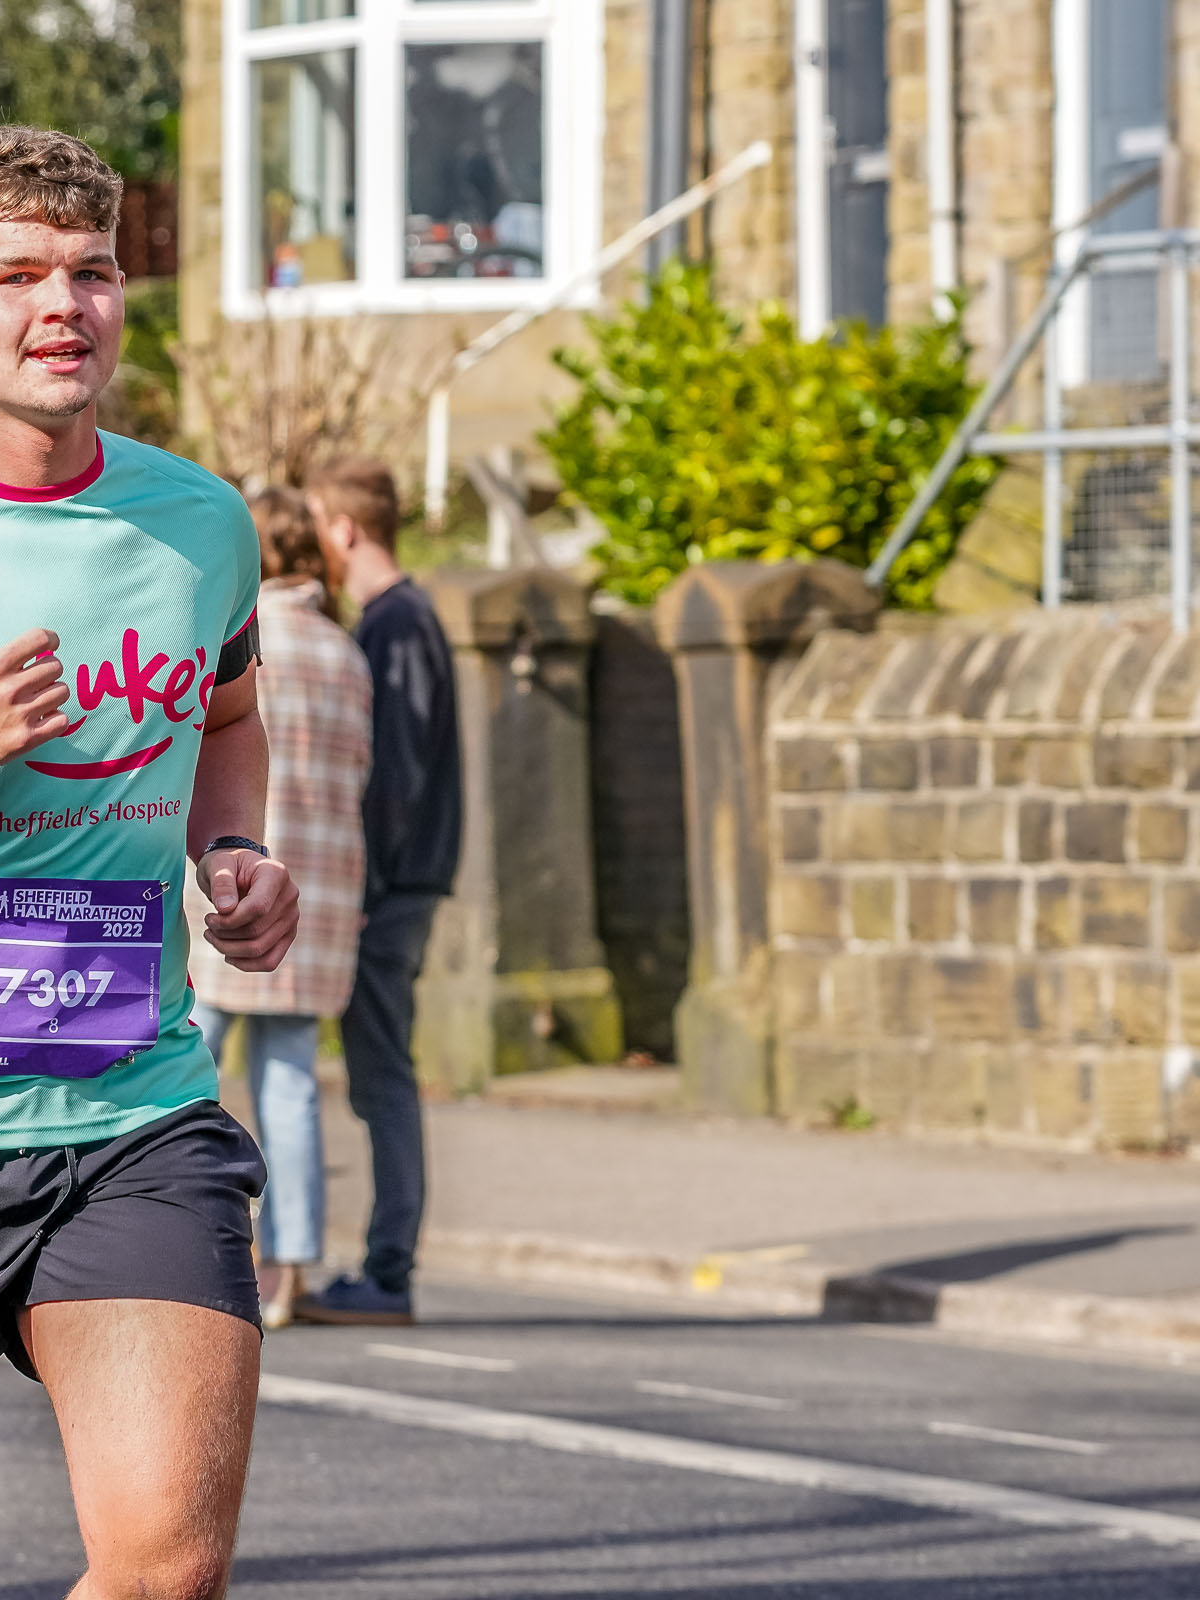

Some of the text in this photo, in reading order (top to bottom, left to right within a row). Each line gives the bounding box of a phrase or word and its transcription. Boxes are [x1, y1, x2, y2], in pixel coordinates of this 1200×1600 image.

[36, 628, 216, 738] uke's
[104, 796, 181, 825] Hospice
[14, 889, 90, 905] SHEFFIELD
[14, 904, 145, 921] HALF MARATHON
[102, 923, 143, 938] 2022
[48, 1018, 59, 1034] 8
